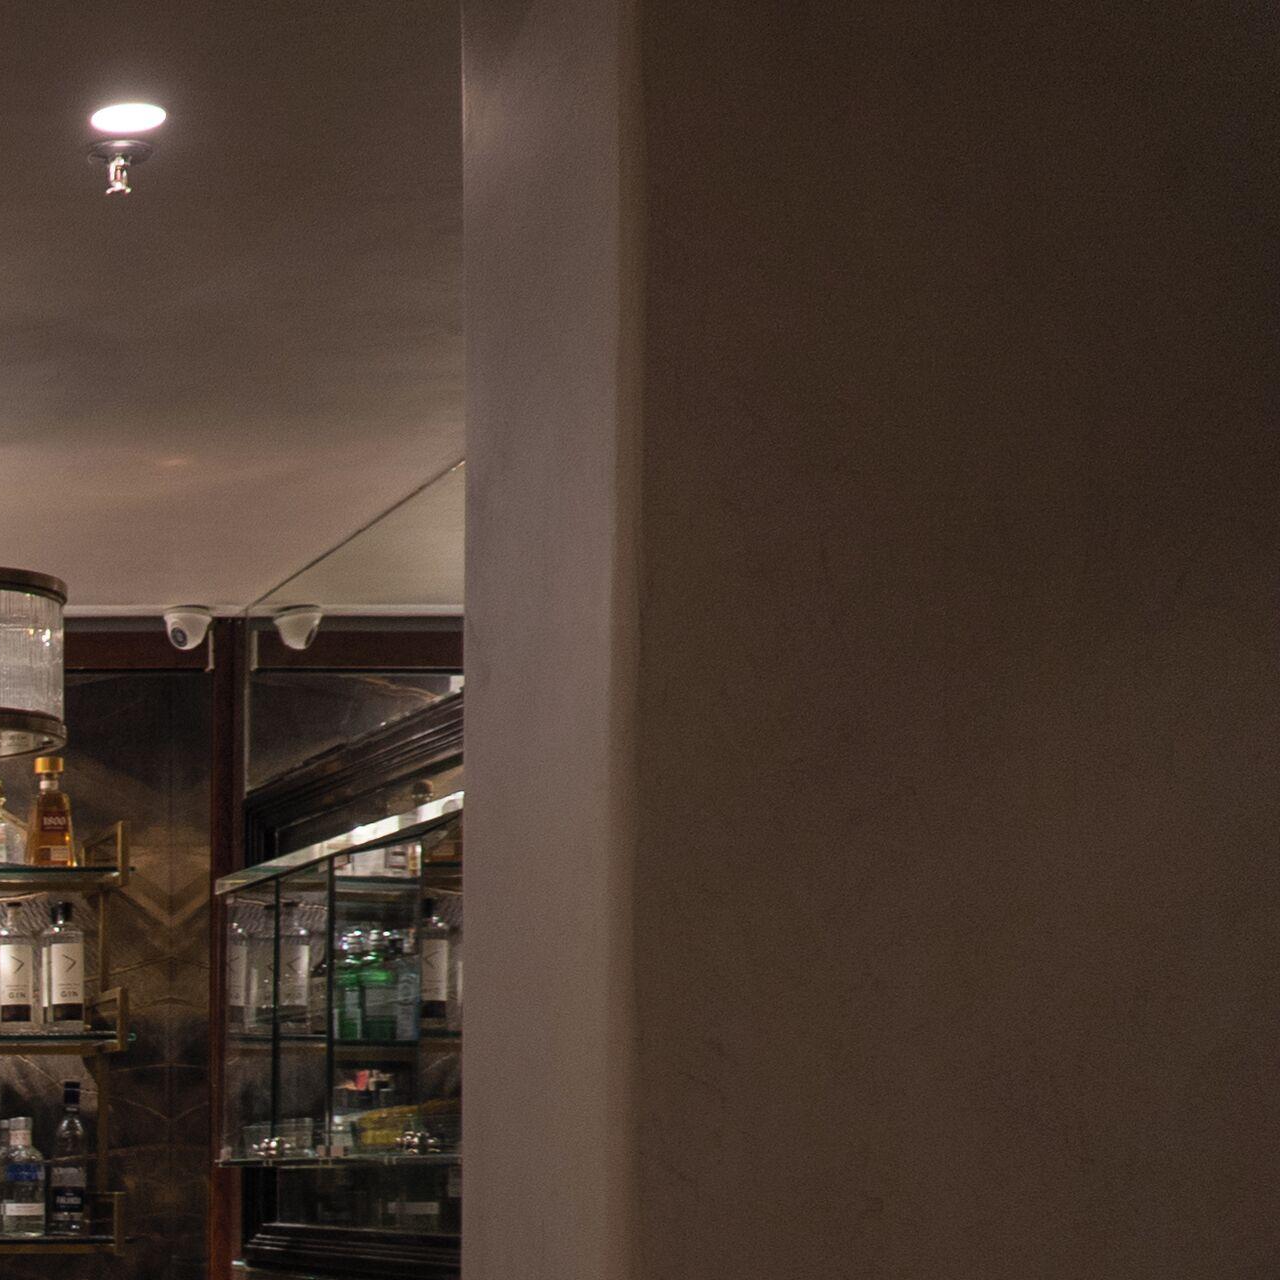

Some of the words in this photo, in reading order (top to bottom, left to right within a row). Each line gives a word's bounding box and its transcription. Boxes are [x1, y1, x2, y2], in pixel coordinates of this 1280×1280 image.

[42, 816, 67, 826] 1800
[8, 991, 27, 999] GIN
[60, 990, 79, 999] GIN
